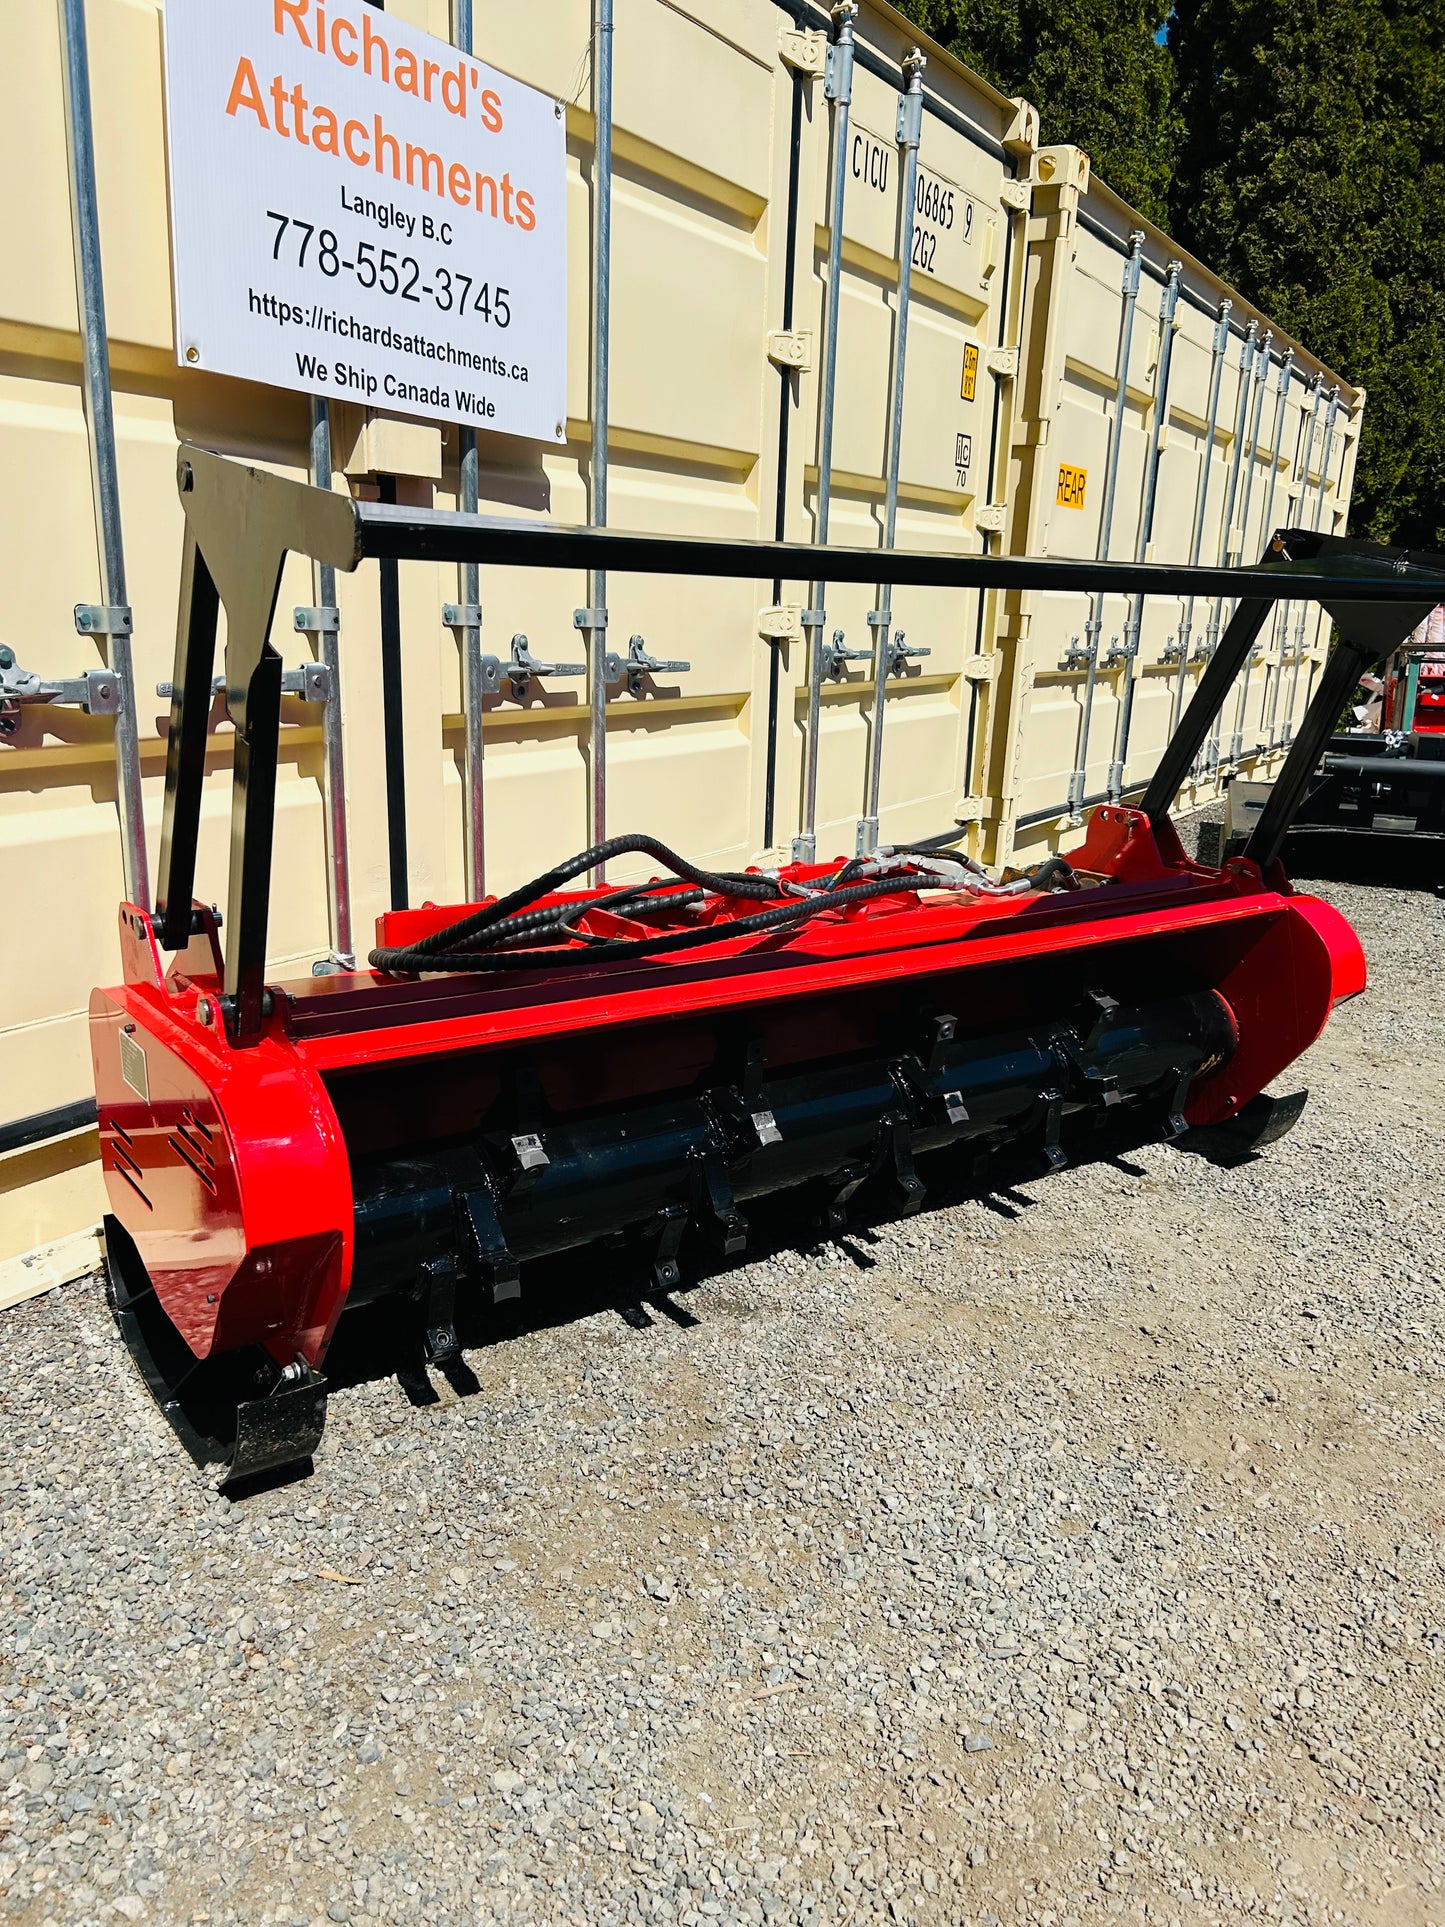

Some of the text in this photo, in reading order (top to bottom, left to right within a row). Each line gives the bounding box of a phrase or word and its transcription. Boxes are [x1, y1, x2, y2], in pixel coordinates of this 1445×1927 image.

[273, 0, 503, 134] Richard's
[225, 56, 537, 232] Attachments
[340, 185, 453, 246] Langley B.C
[852, 135, 973, 239] CICU 06865 9
[266, 210, 512, 329] 778-552-3745
[911, 225, 937, 274] 2G2
[248, 287, 530, 383] https://richardsattachments.ca
[296, 352, 496, 419] We Ship Canada Wide
[956, 469, 967, 487] 70
[1056, 468, 1086, 505] REAR
